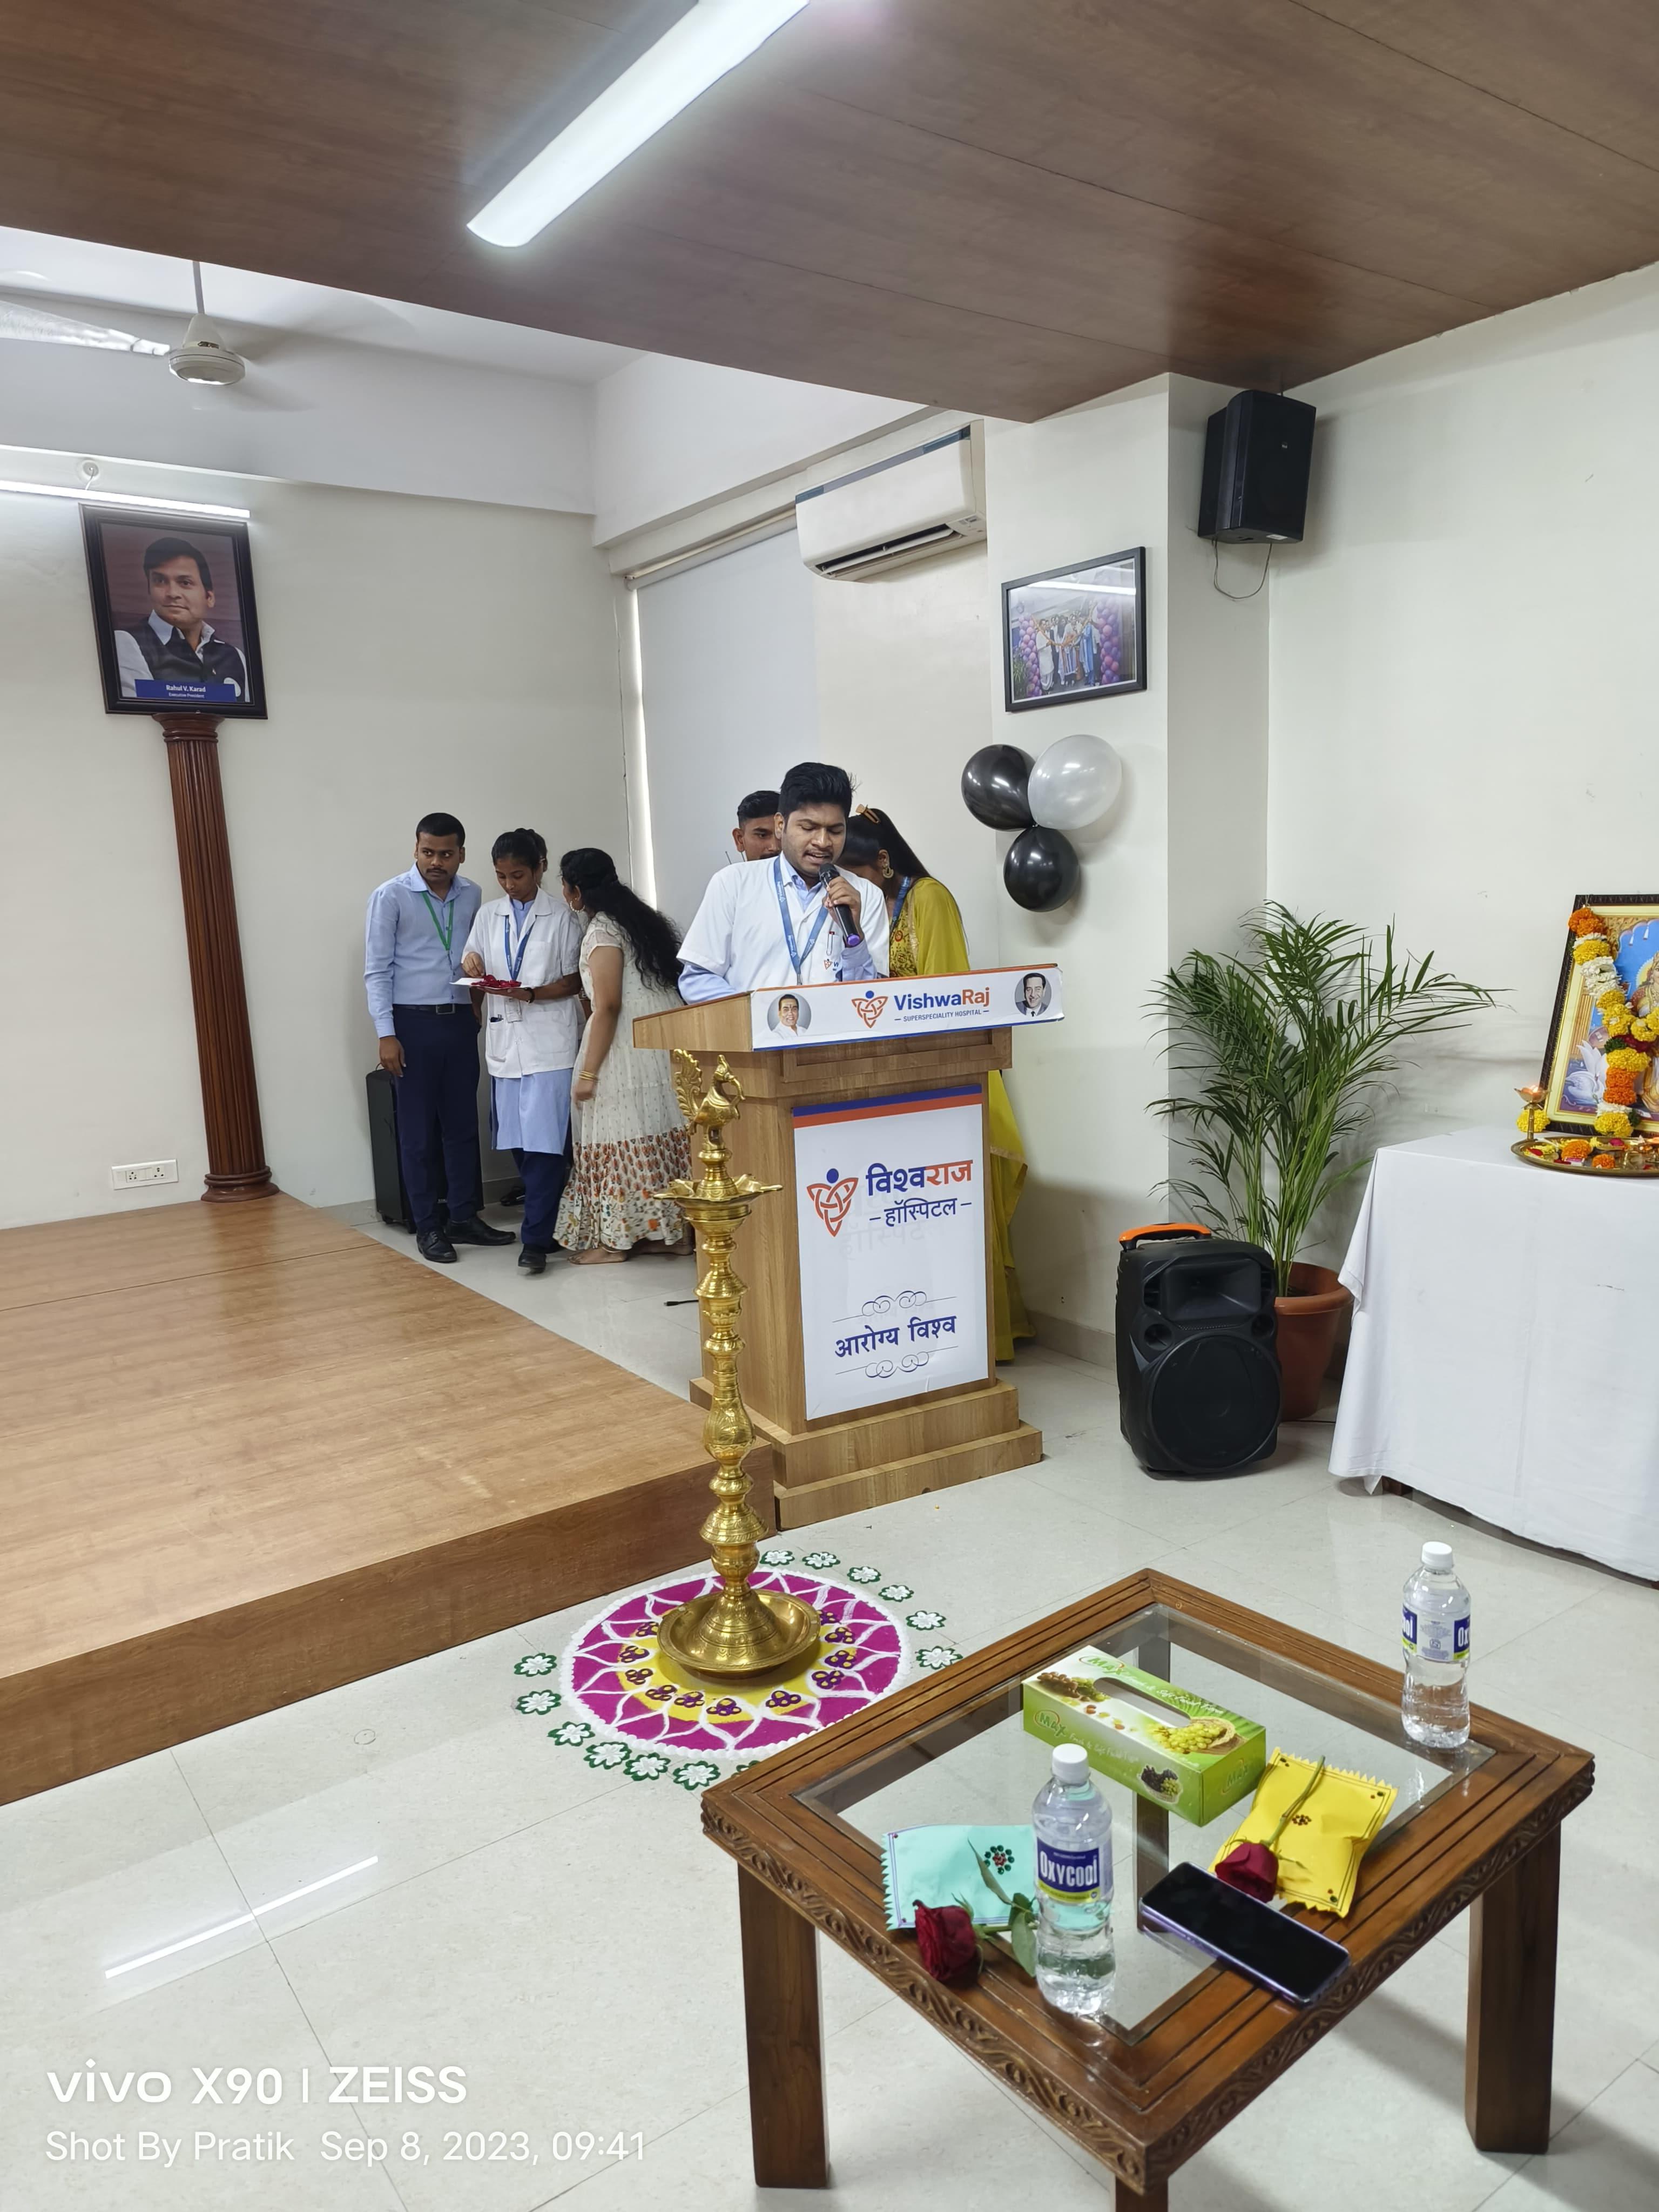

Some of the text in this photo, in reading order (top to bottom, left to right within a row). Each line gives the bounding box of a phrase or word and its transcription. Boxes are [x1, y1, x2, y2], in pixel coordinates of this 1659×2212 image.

[894, 987, 990, 1011] VishwaRaj
[903, 1009, 982, 1022] SUPERSPECIALITY HOSPITAL
[866, 1159, 973, 1196] विश्वराज
[884, 1197, 957, 1227] हॉस्पिटल
[834, 1325, 900, 1358] आरोग्य
[907, 1316, 957, 1342] विश्व
